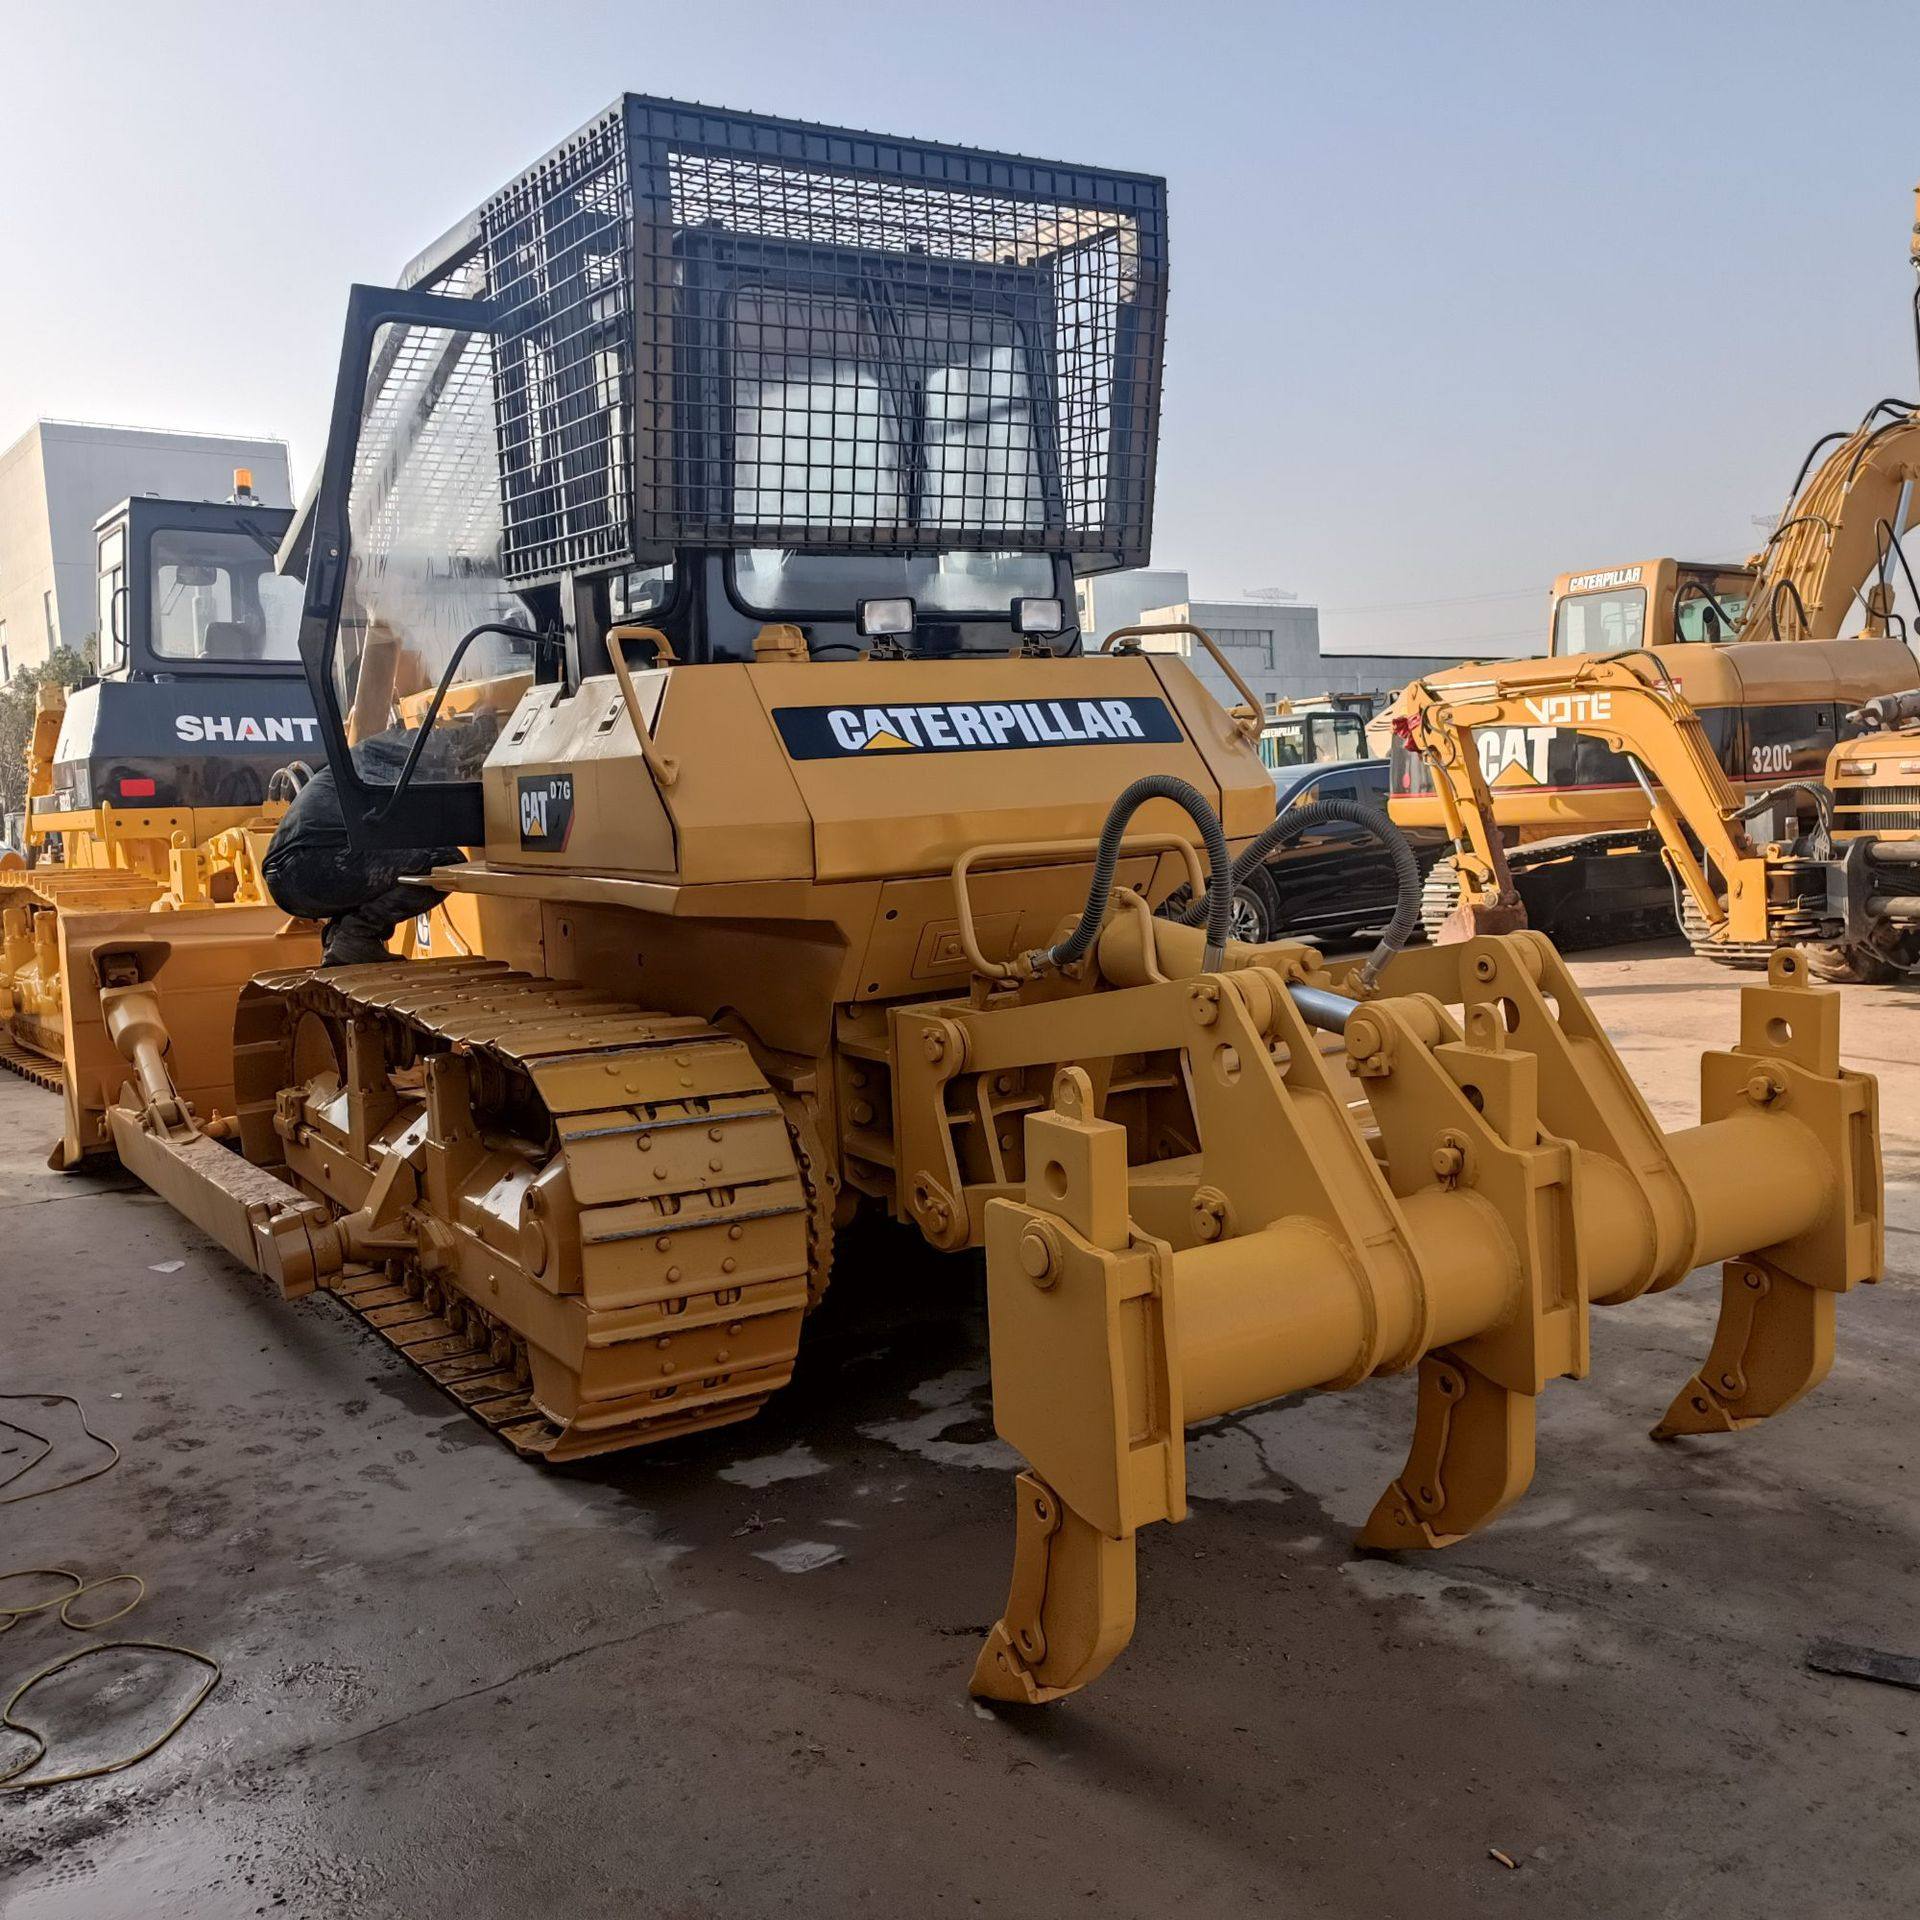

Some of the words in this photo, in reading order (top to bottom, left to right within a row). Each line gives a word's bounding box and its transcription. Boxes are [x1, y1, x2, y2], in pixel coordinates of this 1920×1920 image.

[1569, 567, 1642, 592] CATERPILLAR
[827, 700, 1145, 750] CATERPILLAR
[1524, 692, 1611, 724] VOTE
[1477, 727, 1557, 786] CAT
[1752, 744, 1792, 773] 320C
[521, 791, 548, 836] CAT
